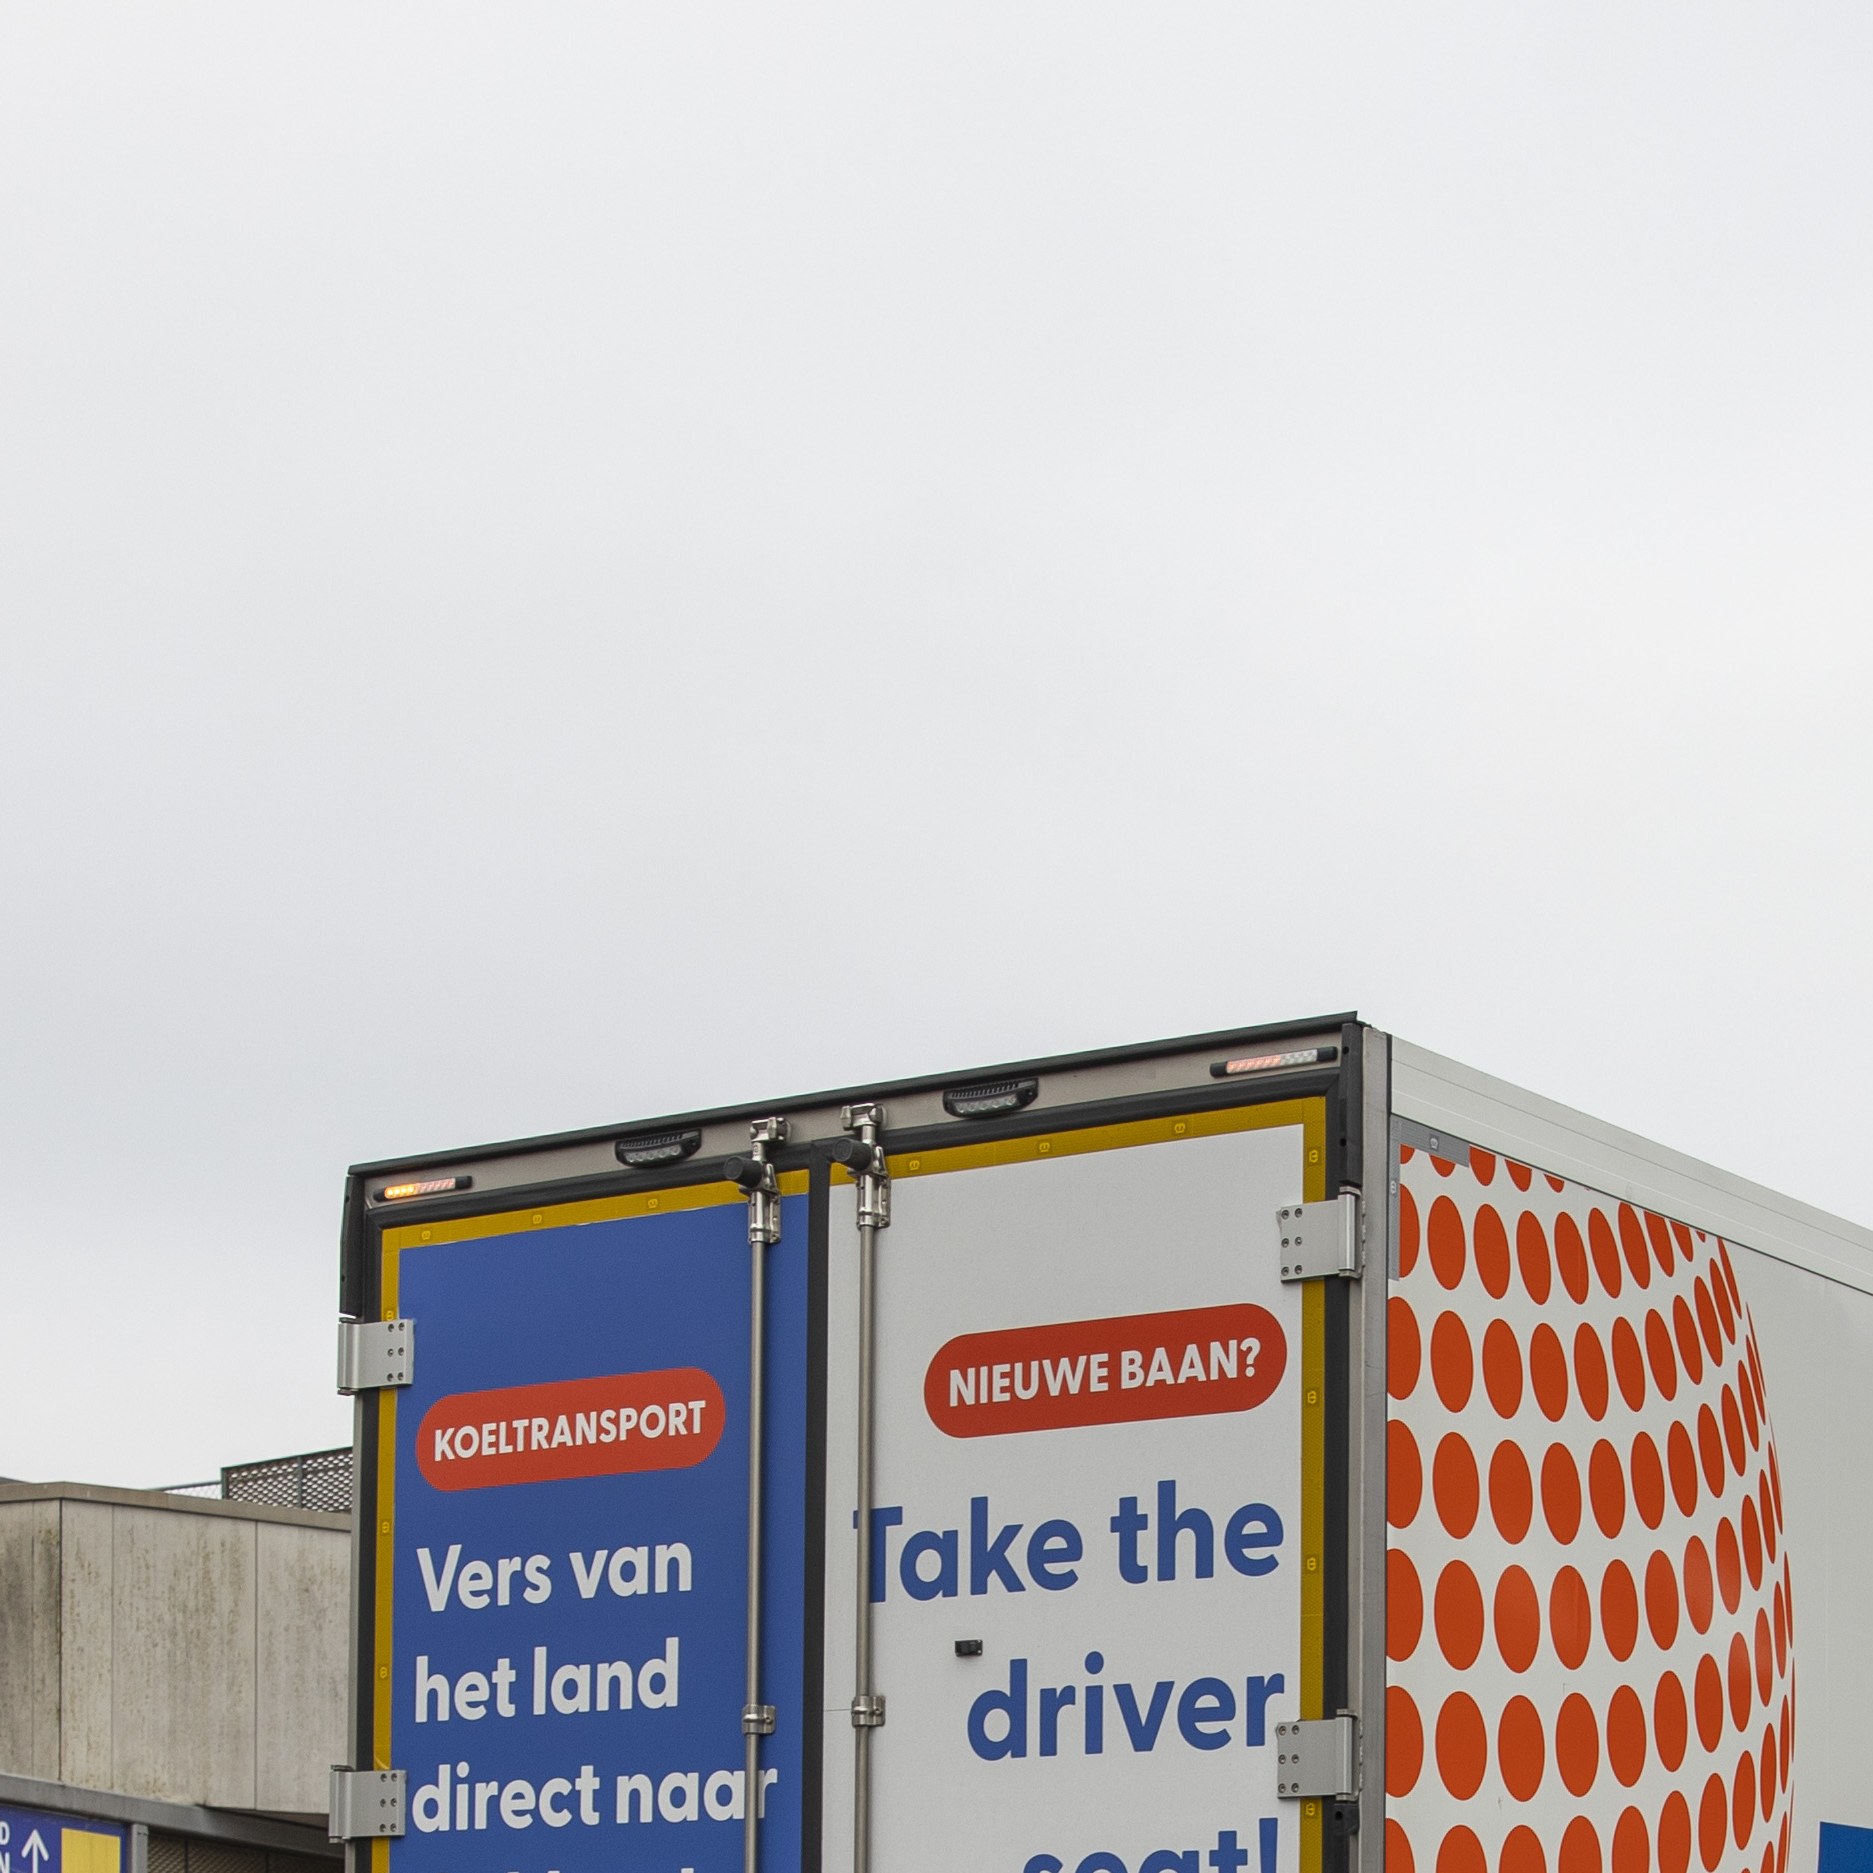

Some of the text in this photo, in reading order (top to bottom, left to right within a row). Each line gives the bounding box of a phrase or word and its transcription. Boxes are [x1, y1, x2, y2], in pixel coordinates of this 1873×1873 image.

[949, 1337, 1260, 1407] NIEUWE BAAN?
[434, 1400, 707, 1462] KOELTRANSPORT
[416, 1541, 692, 1612] Vers van
[853, 1480, 1283, 1603] Take the
[415, 1636, 679, 1723] het land
[967, 1651, 1285, 1761] driver
[411, 1761, 778, 1833] direct naar
